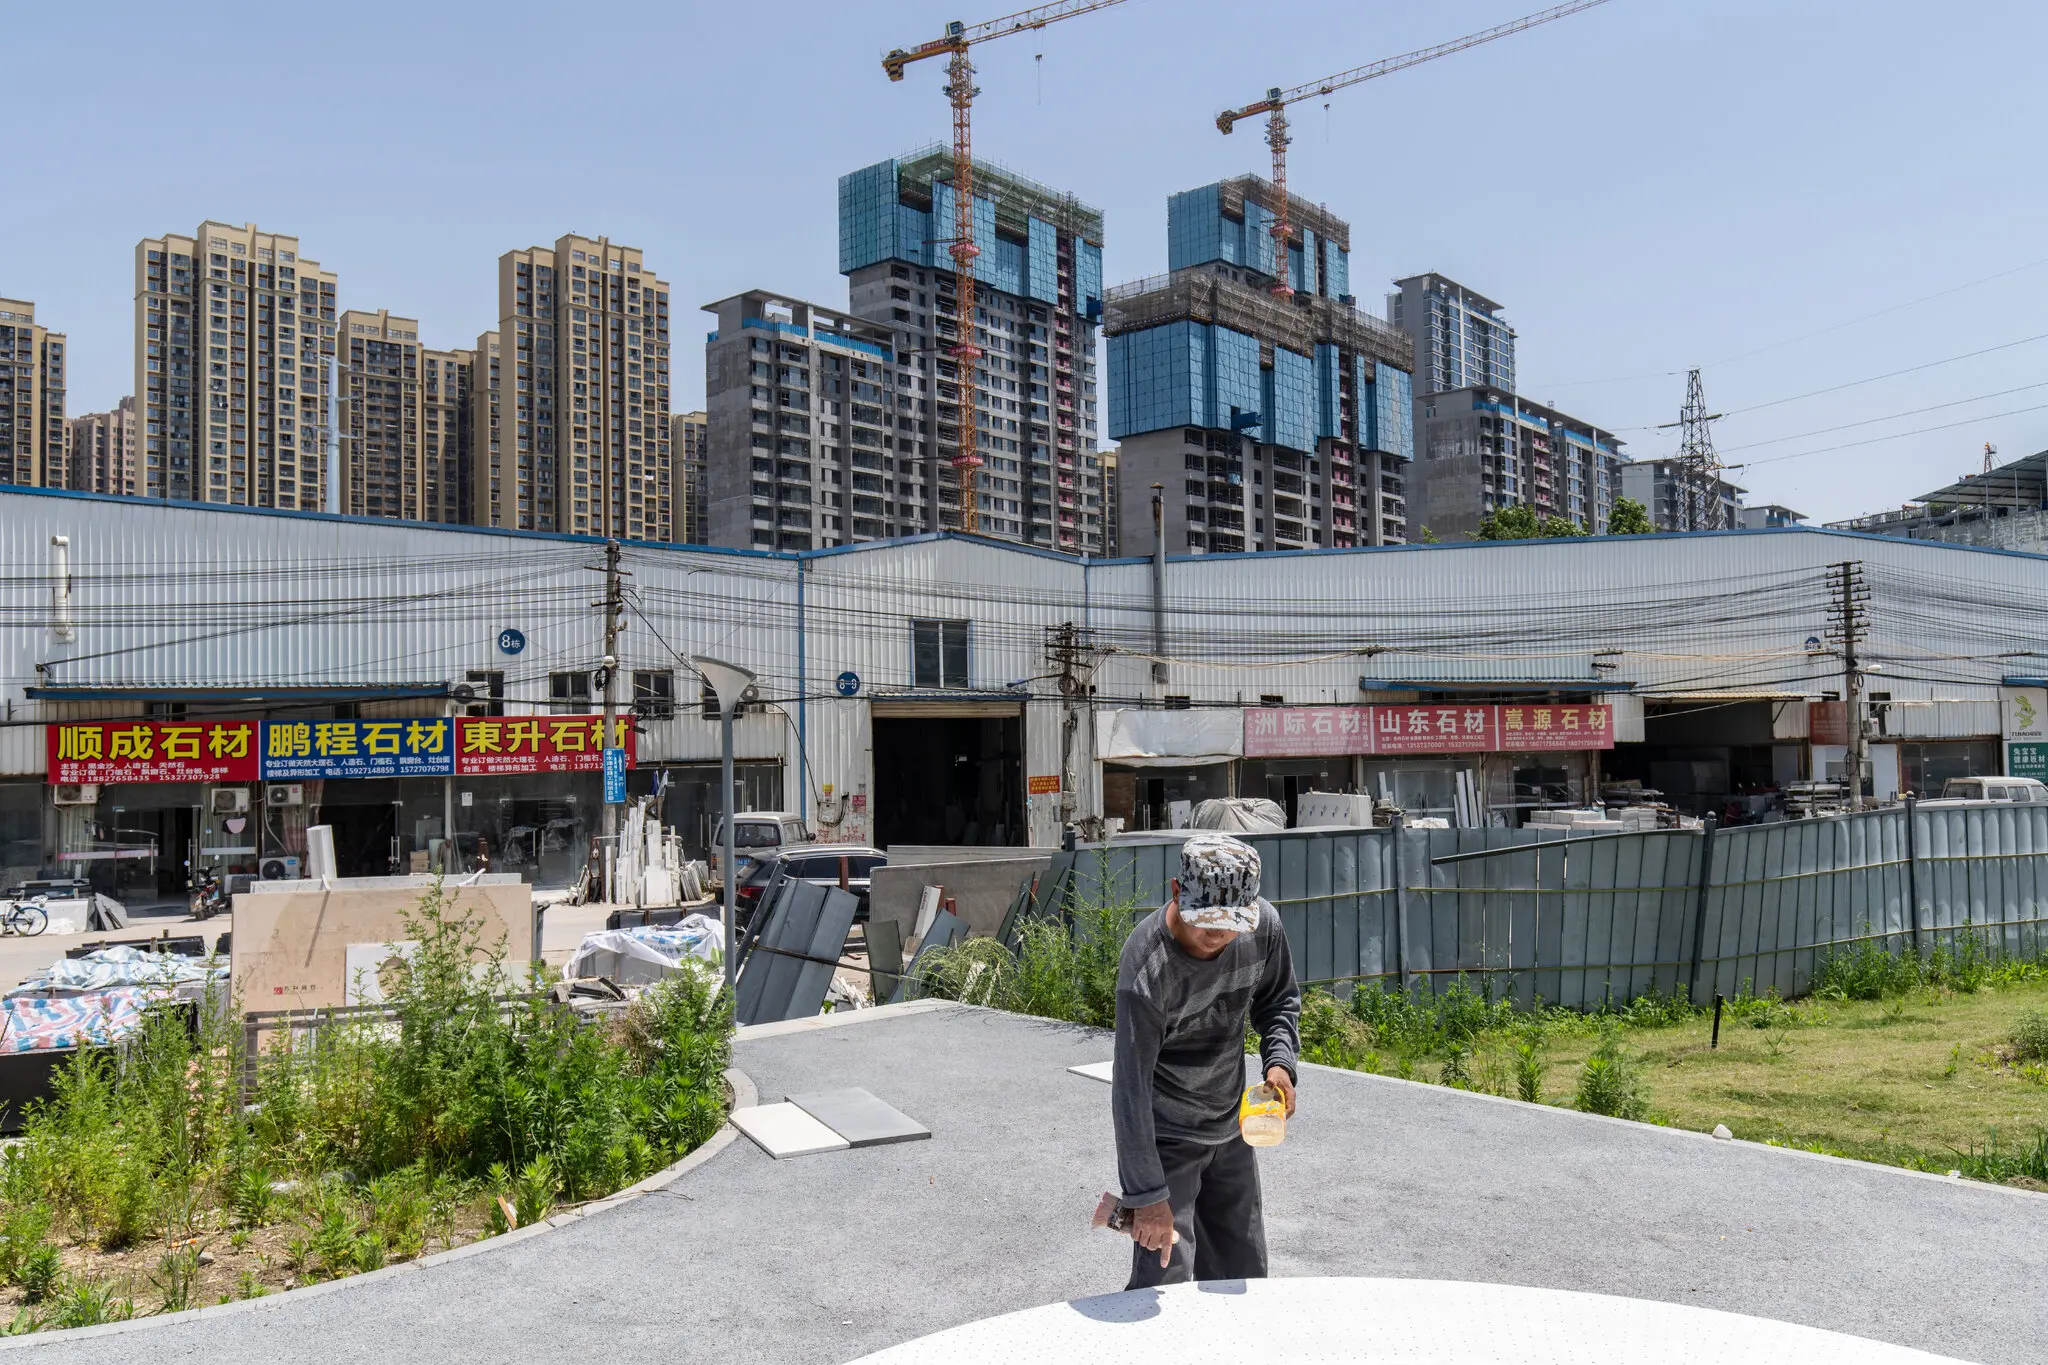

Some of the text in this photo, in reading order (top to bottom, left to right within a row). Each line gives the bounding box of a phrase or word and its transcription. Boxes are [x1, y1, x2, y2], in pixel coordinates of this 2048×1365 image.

[501, 634, 521, 649] 8栋
[1255, 710, 1361, 736] 洲际石材
[1380, 709, 1486, 735] 山东石材
[1505, 708, 1607, 731] 嵩源石材
[57, 724, 252, 761] 顺成石材
[267, 720, 448, 757] 鹏程石材
[400, 765, 450, 773] 15727076798
